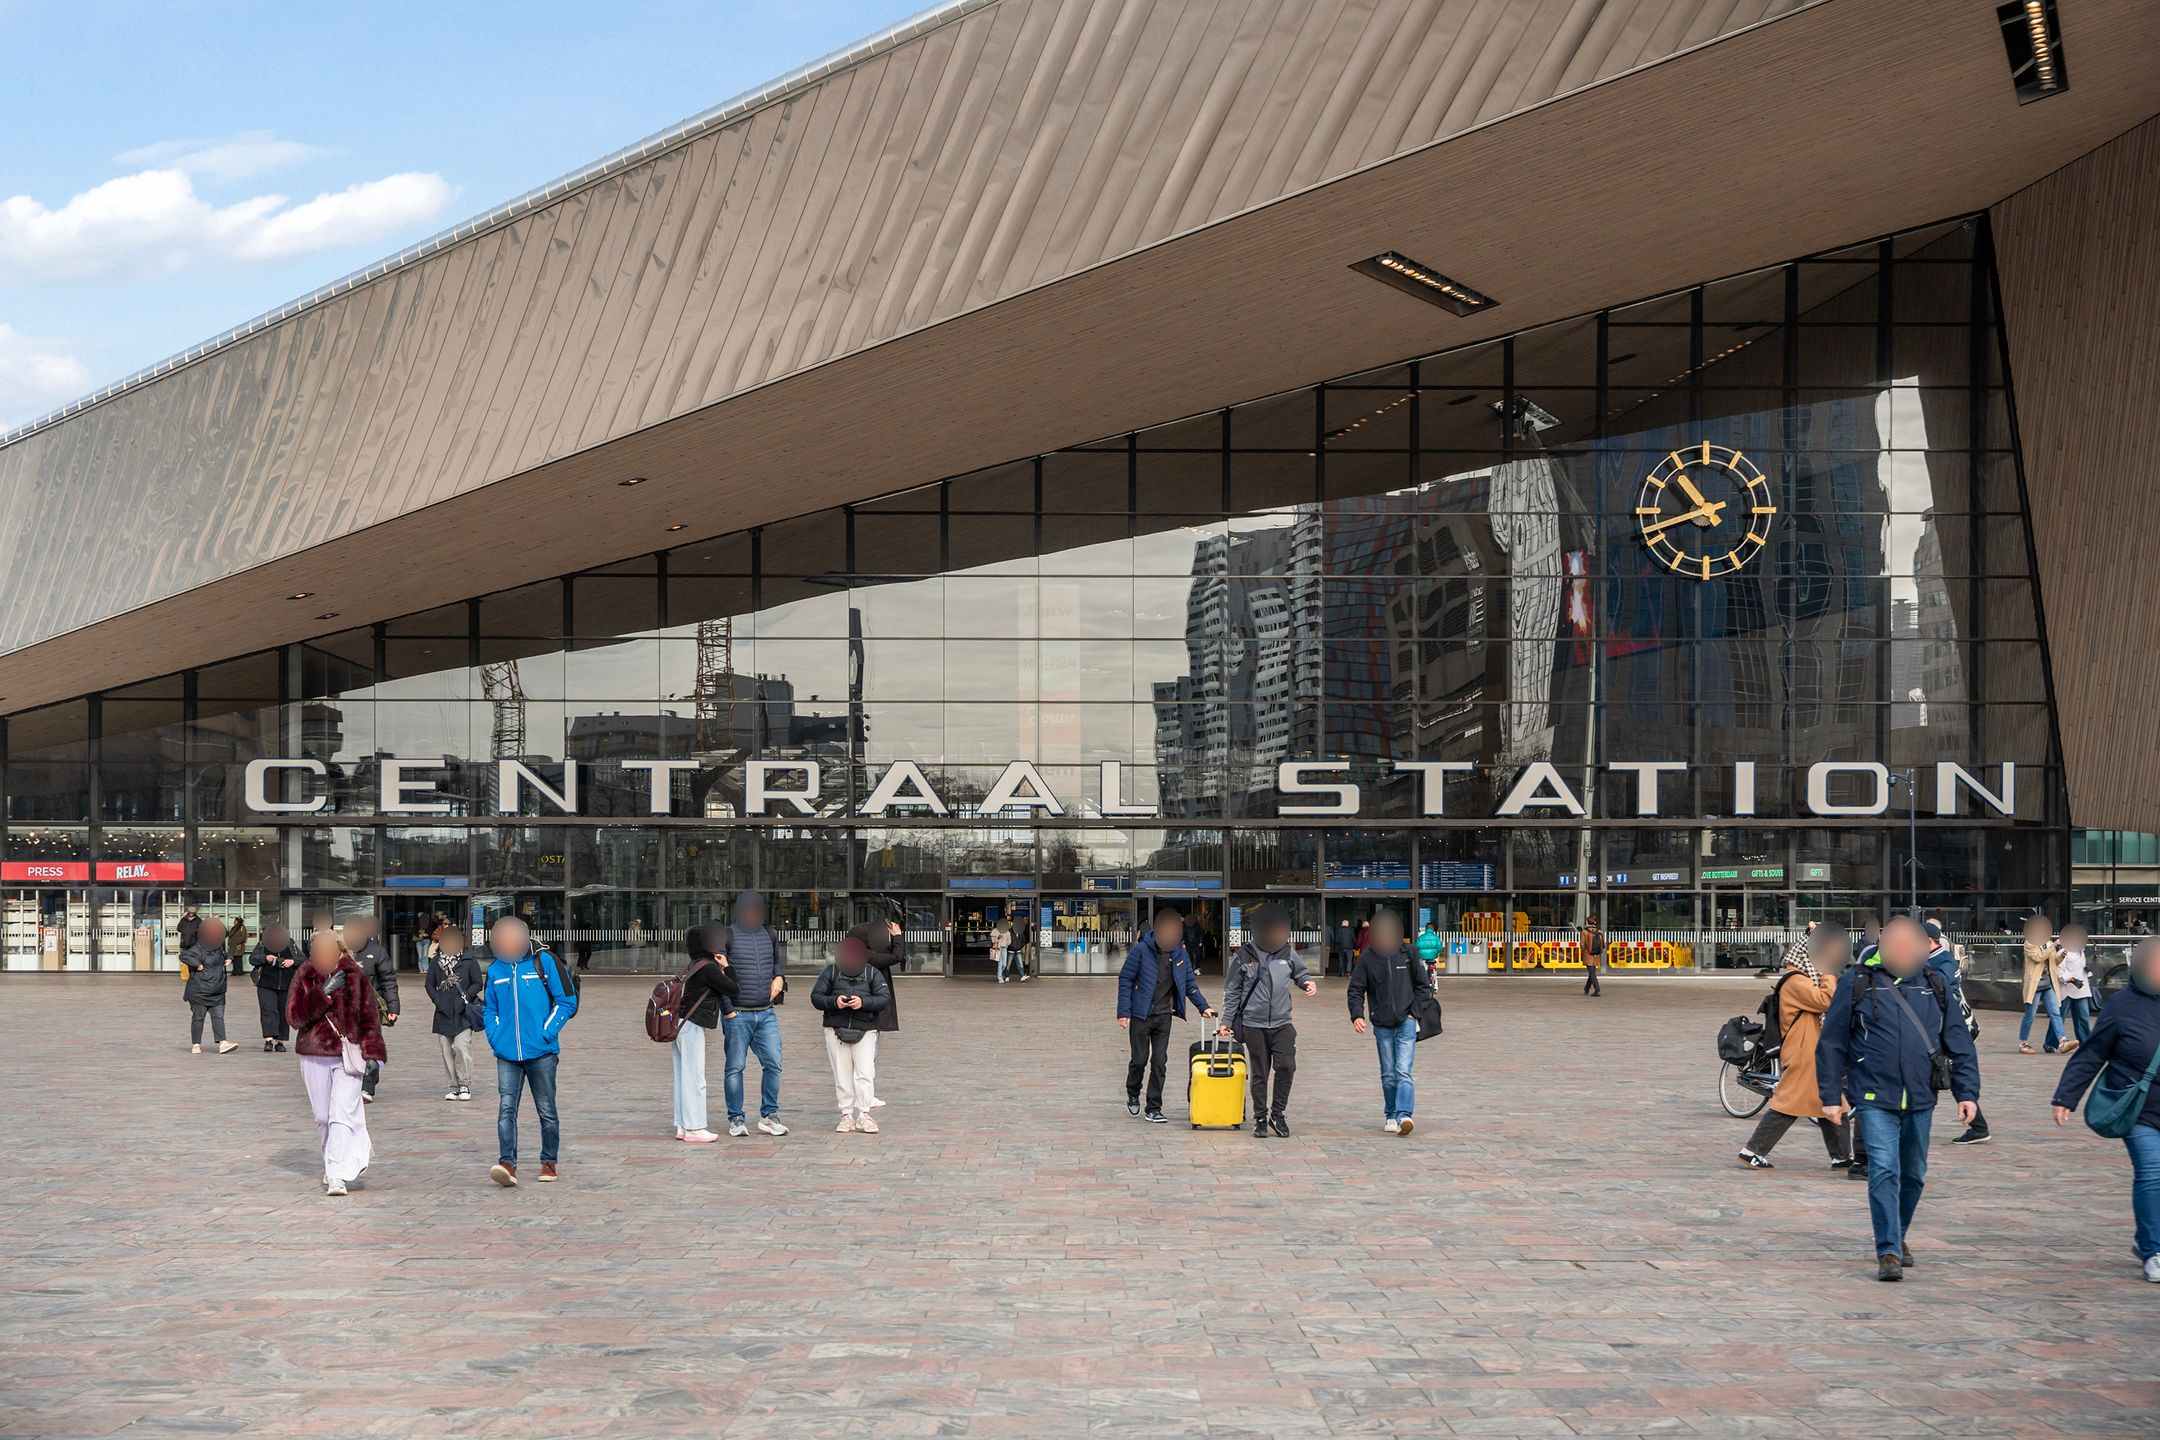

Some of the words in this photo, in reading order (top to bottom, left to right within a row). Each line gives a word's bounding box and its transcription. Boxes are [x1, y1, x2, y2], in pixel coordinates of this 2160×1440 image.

[245, 757, 1158, 816] CENTRAAL
[1277, 760, 2015, 816] STATION
[28, 866, 63, 877] PRESS
[1751, 869, 1764, 877] GIFTS
[1810, 868, 1824, 877] GIFTS
